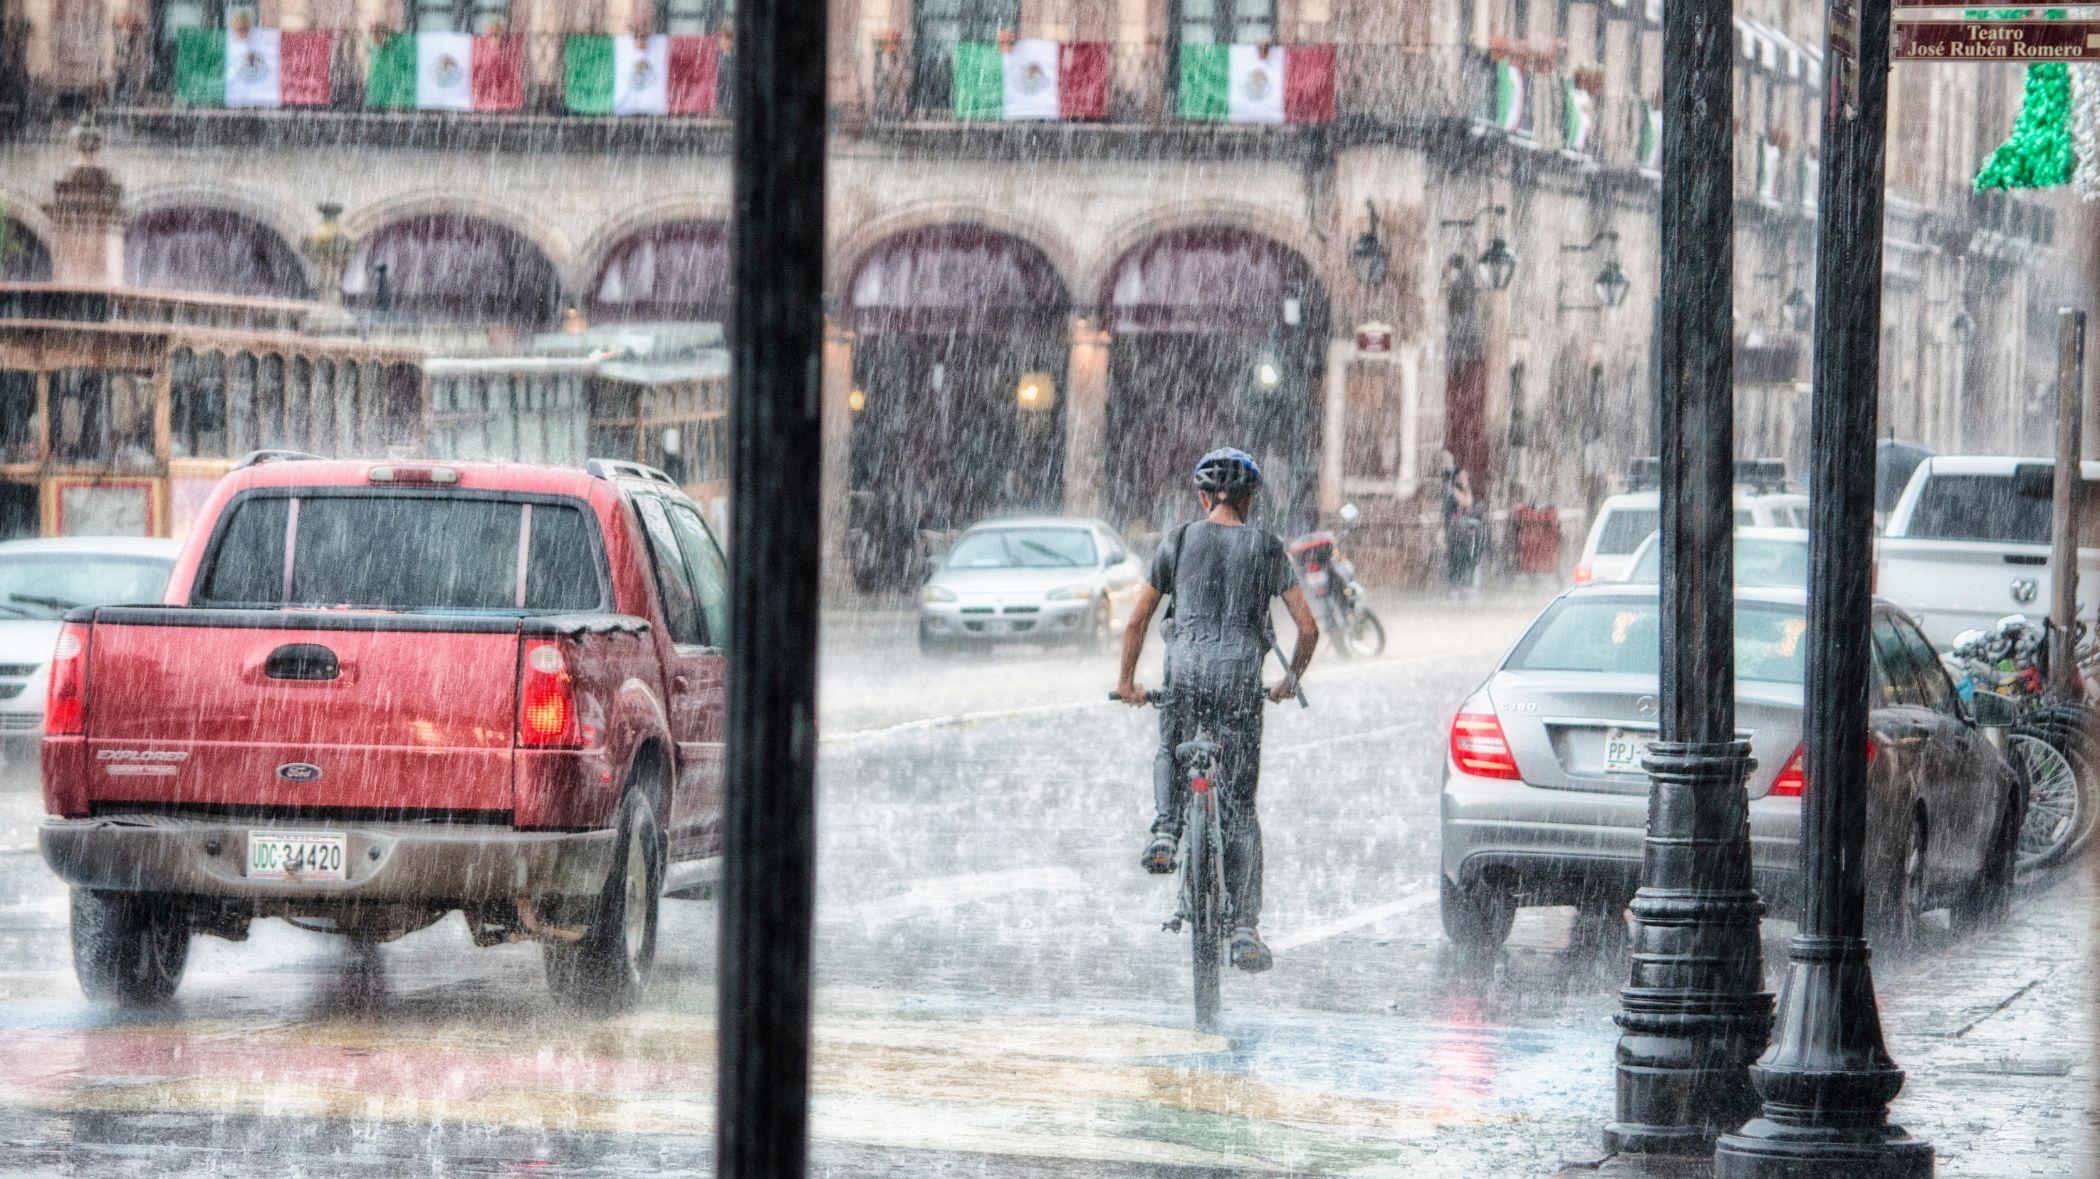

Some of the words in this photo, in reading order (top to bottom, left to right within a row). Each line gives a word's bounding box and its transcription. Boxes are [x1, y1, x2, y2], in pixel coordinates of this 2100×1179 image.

[1967, 25, 2024, 41] Teatro
[1907, 41, 1945, 57] José
[1950, 41, 2007, 57] Rubén
[2013, 42, 2082, 57] Romero
[96, 749, 189, 761] EXPLORER
[1608, 742, 1643, 761] PPJ-
[253, 843, 341, 870] UDC-34420
